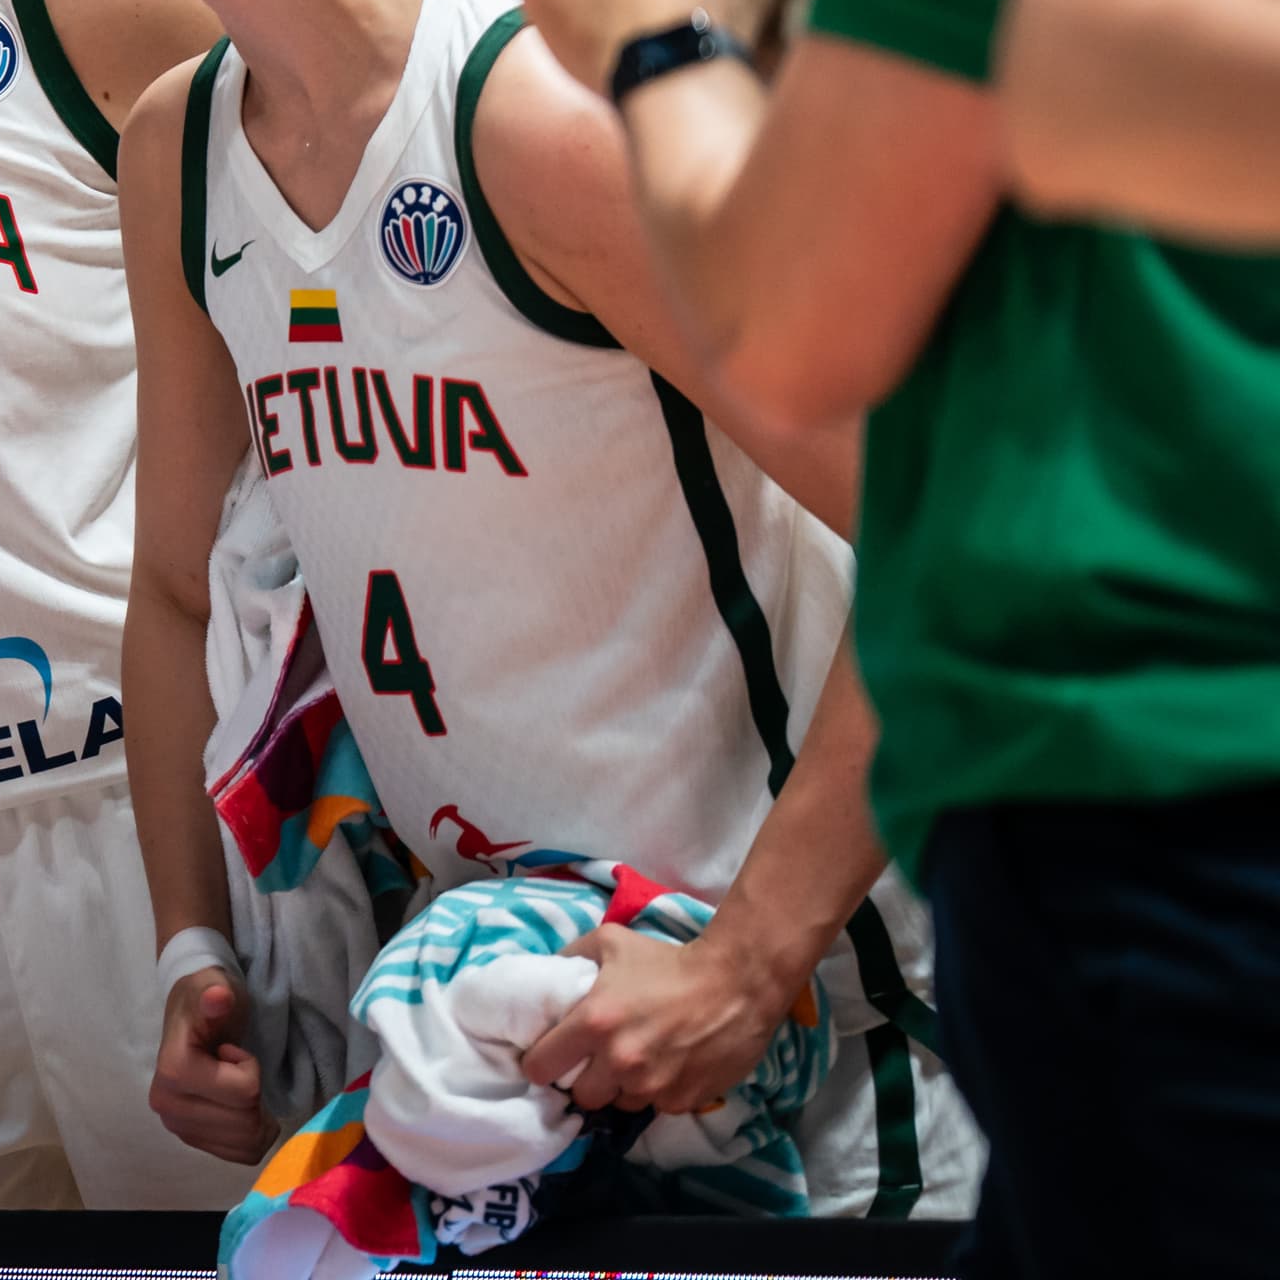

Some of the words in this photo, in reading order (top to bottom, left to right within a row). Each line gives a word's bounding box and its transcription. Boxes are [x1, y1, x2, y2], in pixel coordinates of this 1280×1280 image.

[391, 186, 449, 216] 2025
[246, 366, 529, 480] IETUVA
[362, 570, 447, 737] 4
[482, 1184, 519, 1234] FIB
